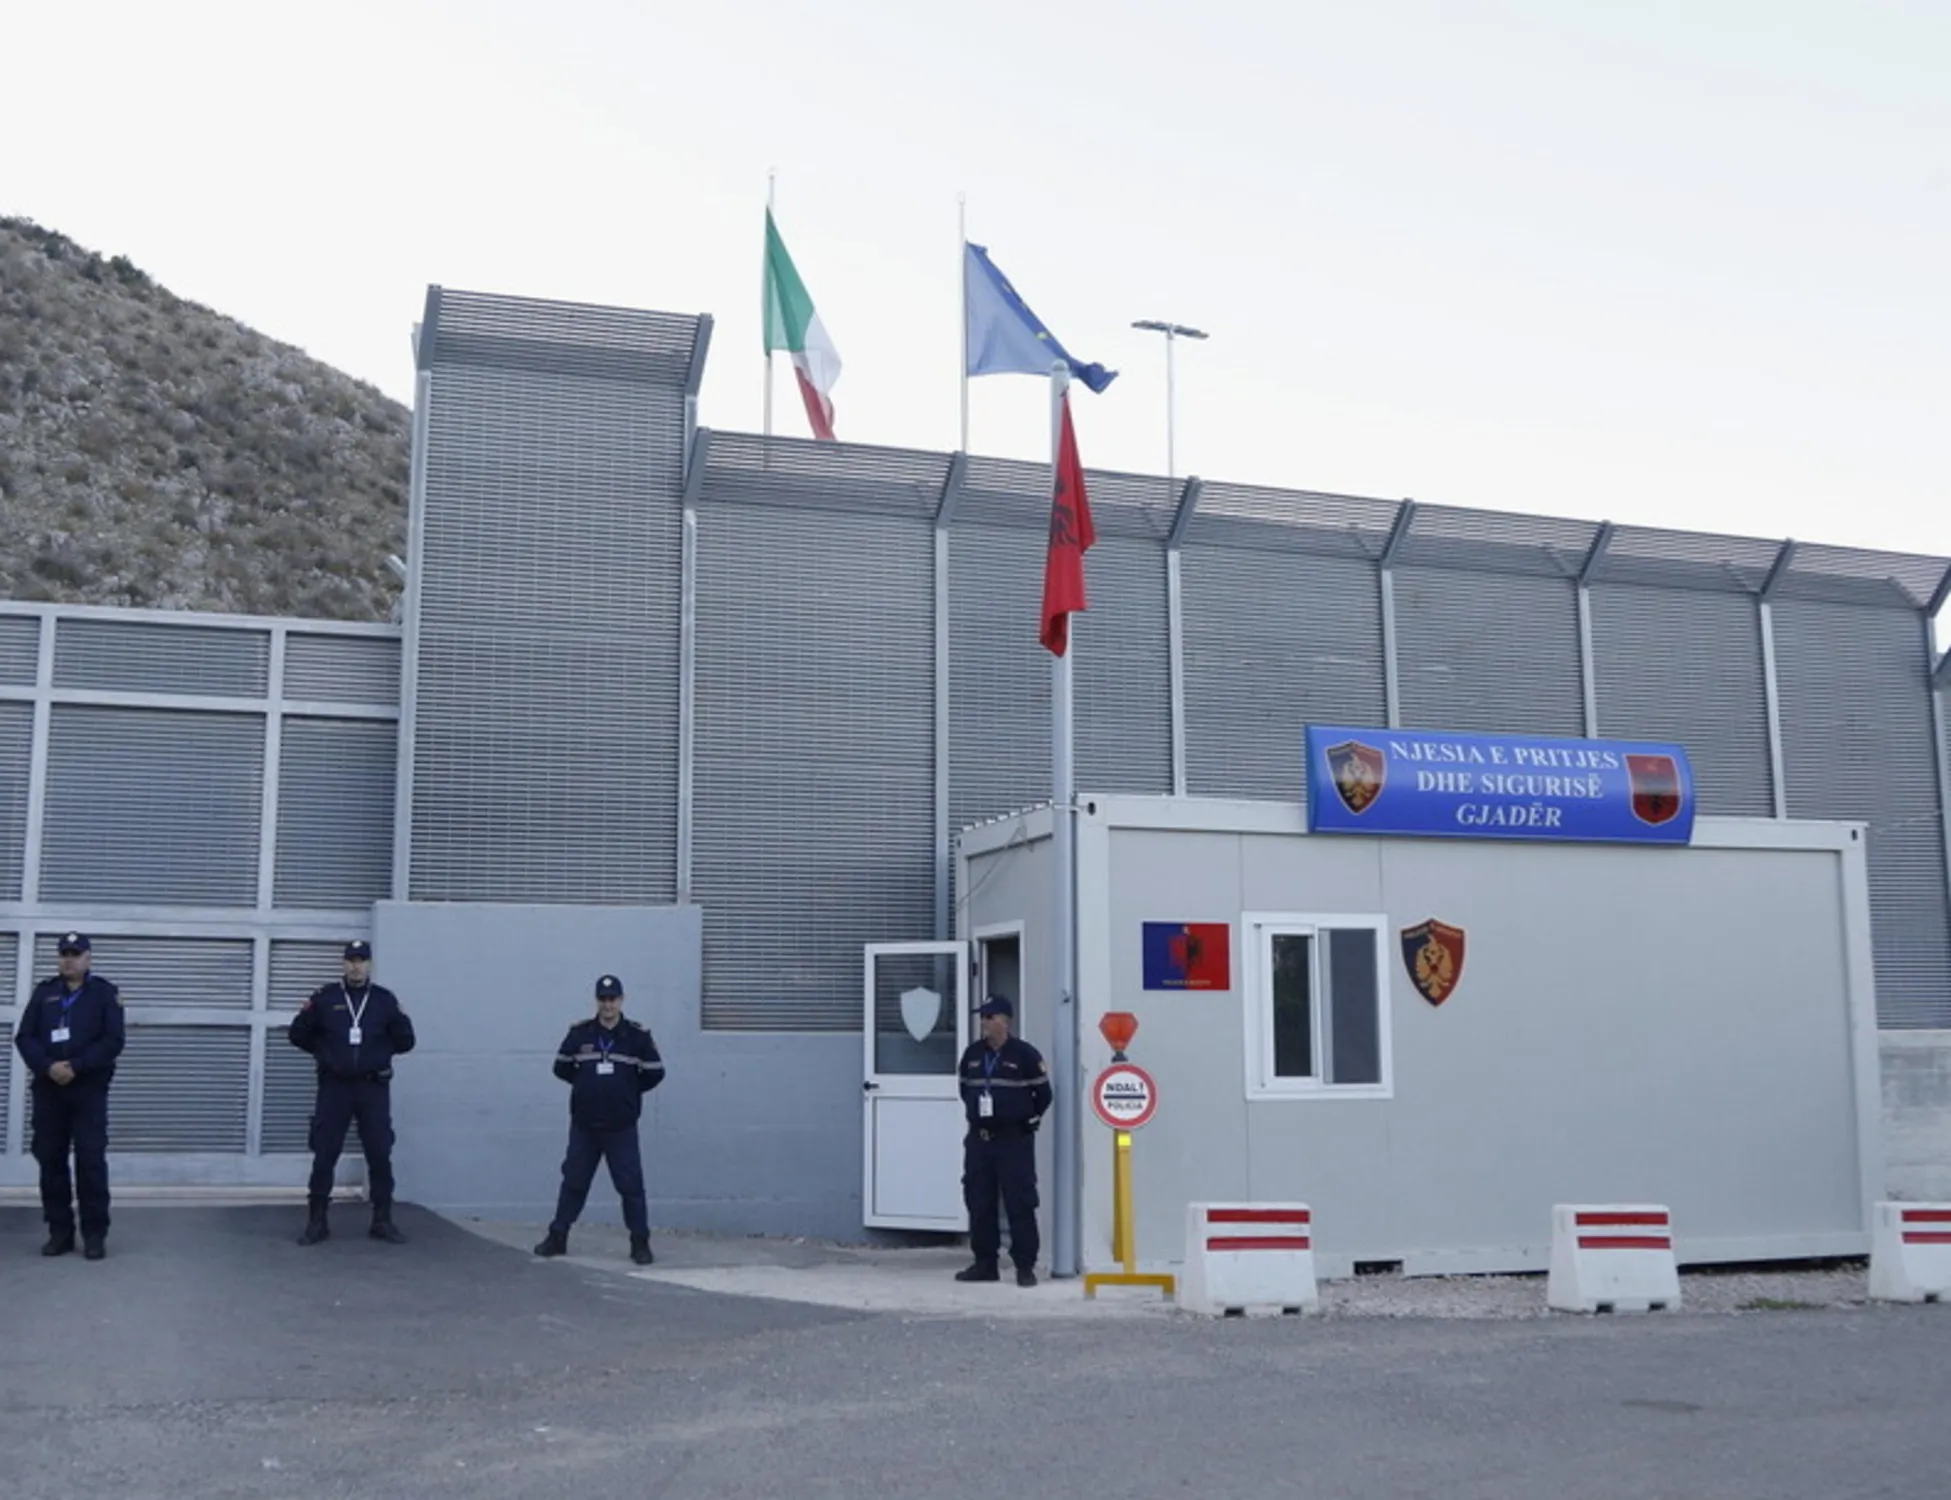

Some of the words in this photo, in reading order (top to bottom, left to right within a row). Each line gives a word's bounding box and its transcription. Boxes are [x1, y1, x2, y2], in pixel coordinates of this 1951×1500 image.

[1390, 741, 1486, 763] NJESIA
[1490, 747, 1507, 764] E
[1516, 748, 1618, 769] PRITJES
[1418, 771, 1473, 792] DHE
[1481, 773, 1604, 798] SIGURISË
[1456, 802, 1562, 827] GJADËR
